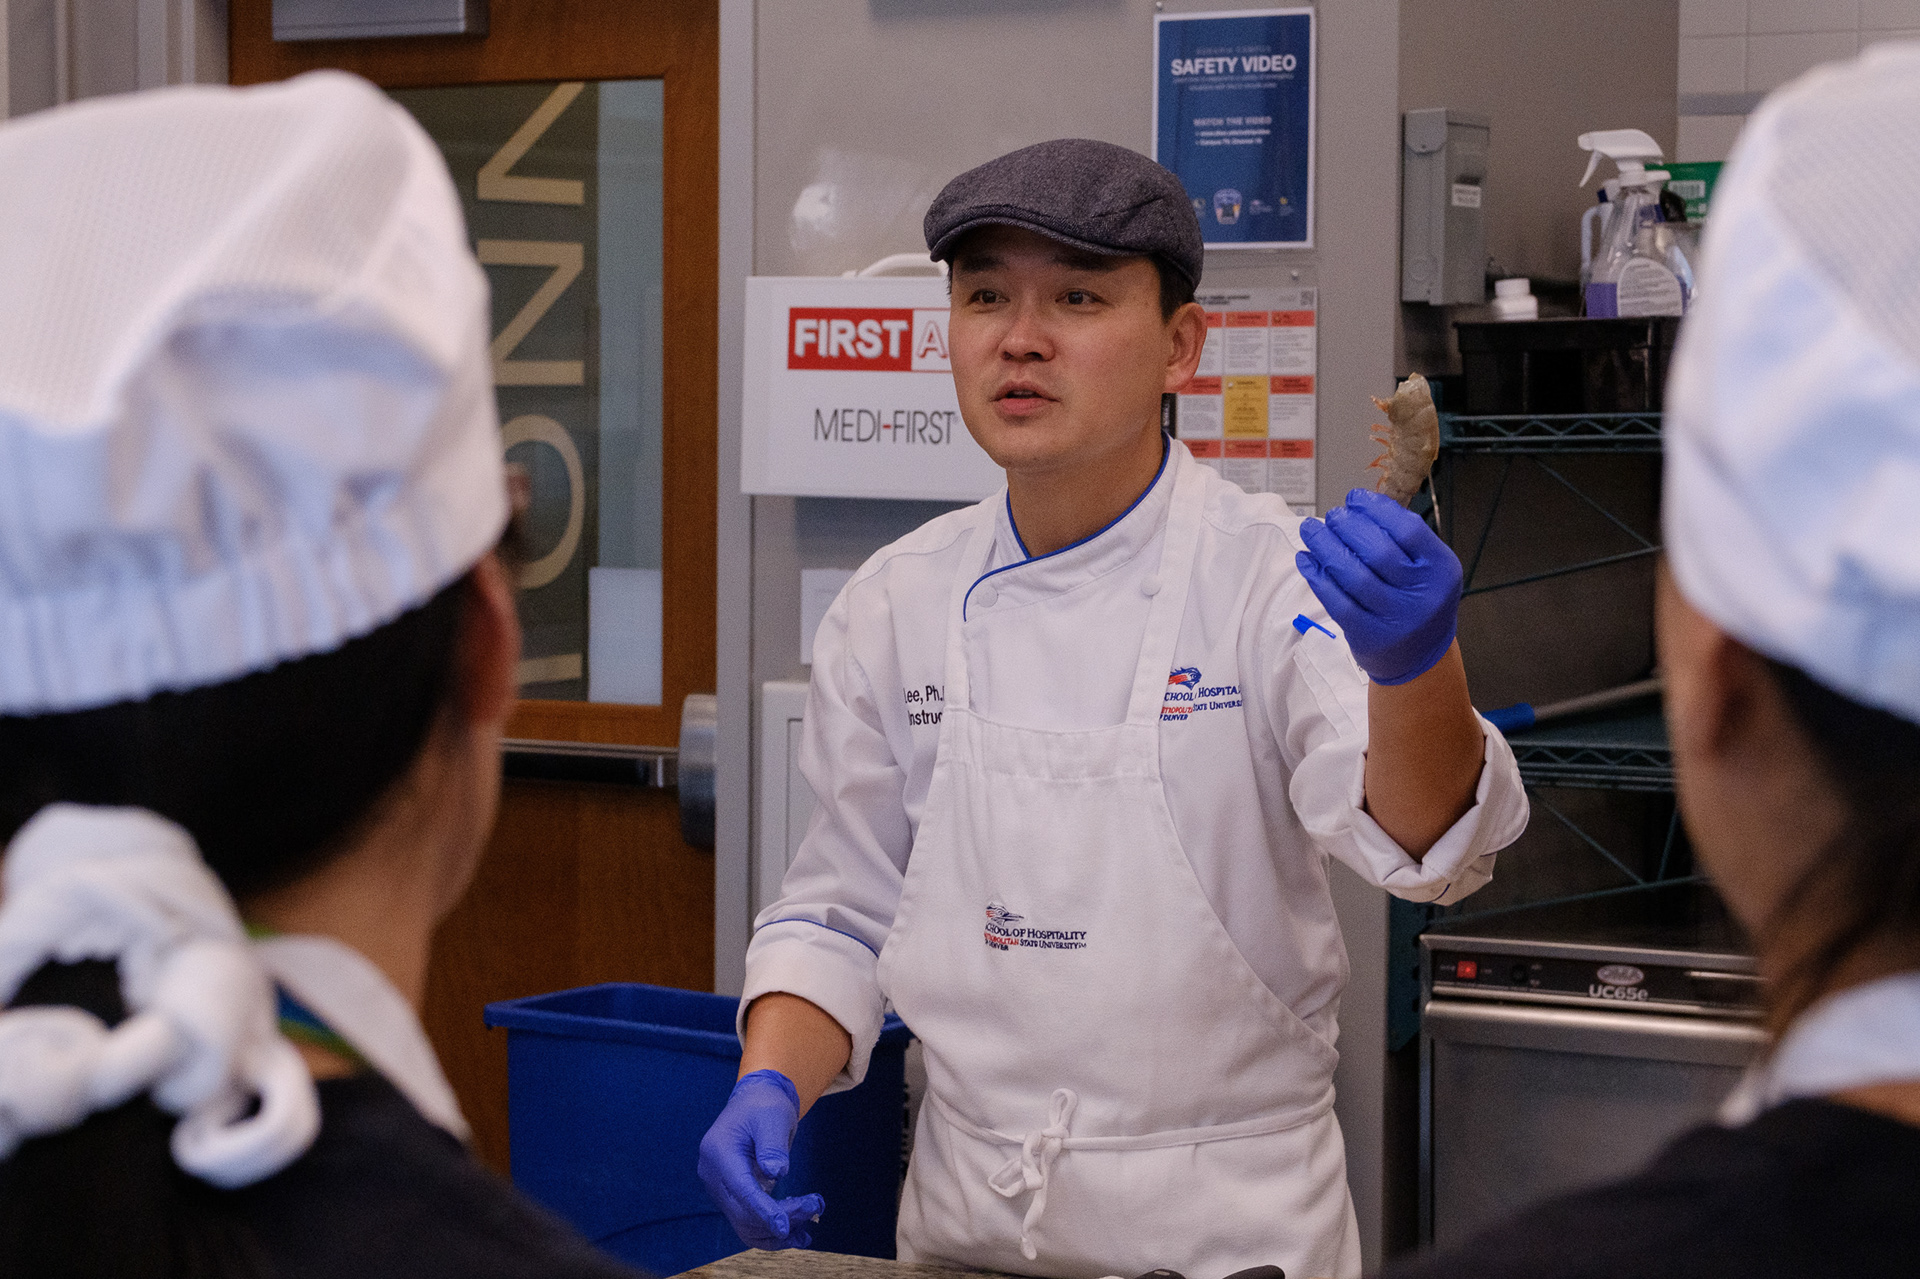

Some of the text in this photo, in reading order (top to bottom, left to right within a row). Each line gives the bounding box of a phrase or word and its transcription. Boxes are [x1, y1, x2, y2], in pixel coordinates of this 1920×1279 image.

[1171, 54, 1297, 75] SAFETY VIDEO
[794, 319, 909, 359] FIRST
[1027, 928, 1087, 940] HOSPITALITY
